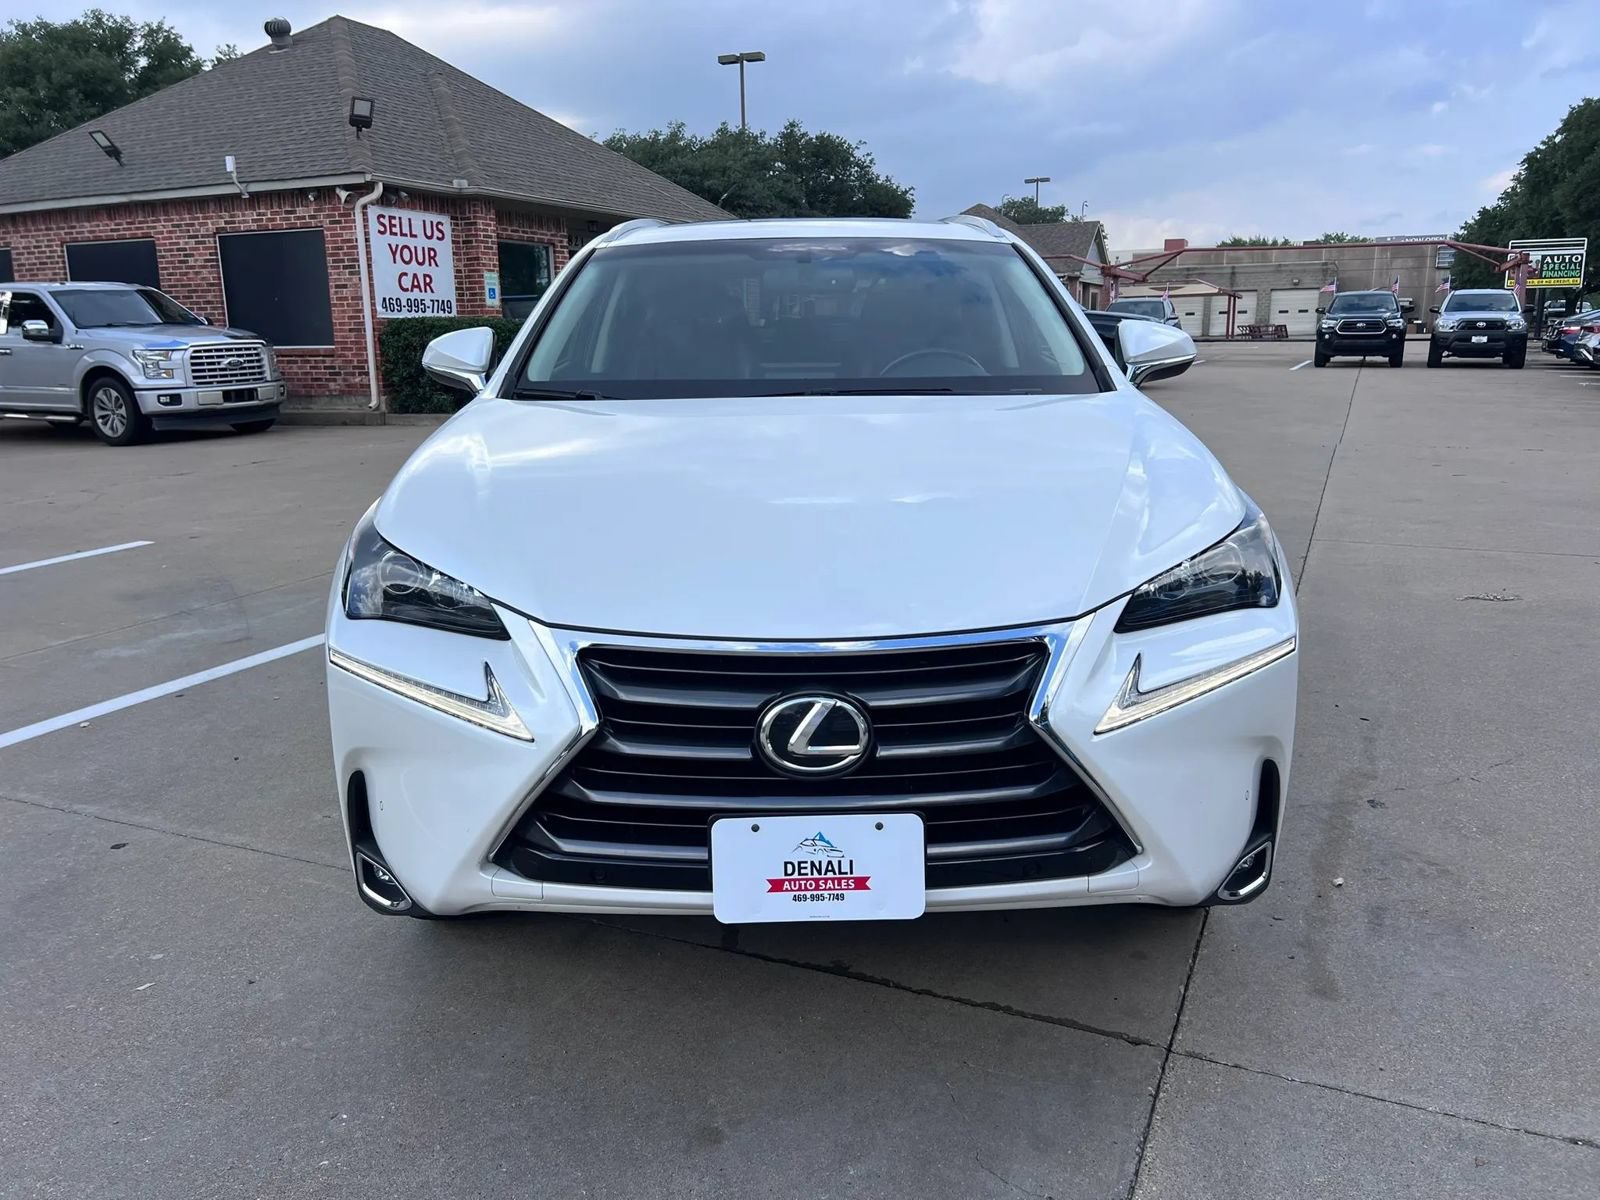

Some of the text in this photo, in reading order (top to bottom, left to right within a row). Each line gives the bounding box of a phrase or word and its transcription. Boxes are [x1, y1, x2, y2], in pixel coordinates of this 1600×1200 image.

[376, 213, 446, 242] SELL US
[388, 243, 439, 267] YOUR
[1544, 254, 1582, 264] AUTO
[1542, 270, 1581, 278] FINANCING
[1543, 263, 1581, 271] SPECIAL
[398, 271, 435, 294] CAR
[381, 296, 453, 314] 469-995-7749
[783, 859, 854, 877] DENALI
[783, 879, 855, 891] AUTO SALES
[792, 893, 845, 903] 469-995-7749
